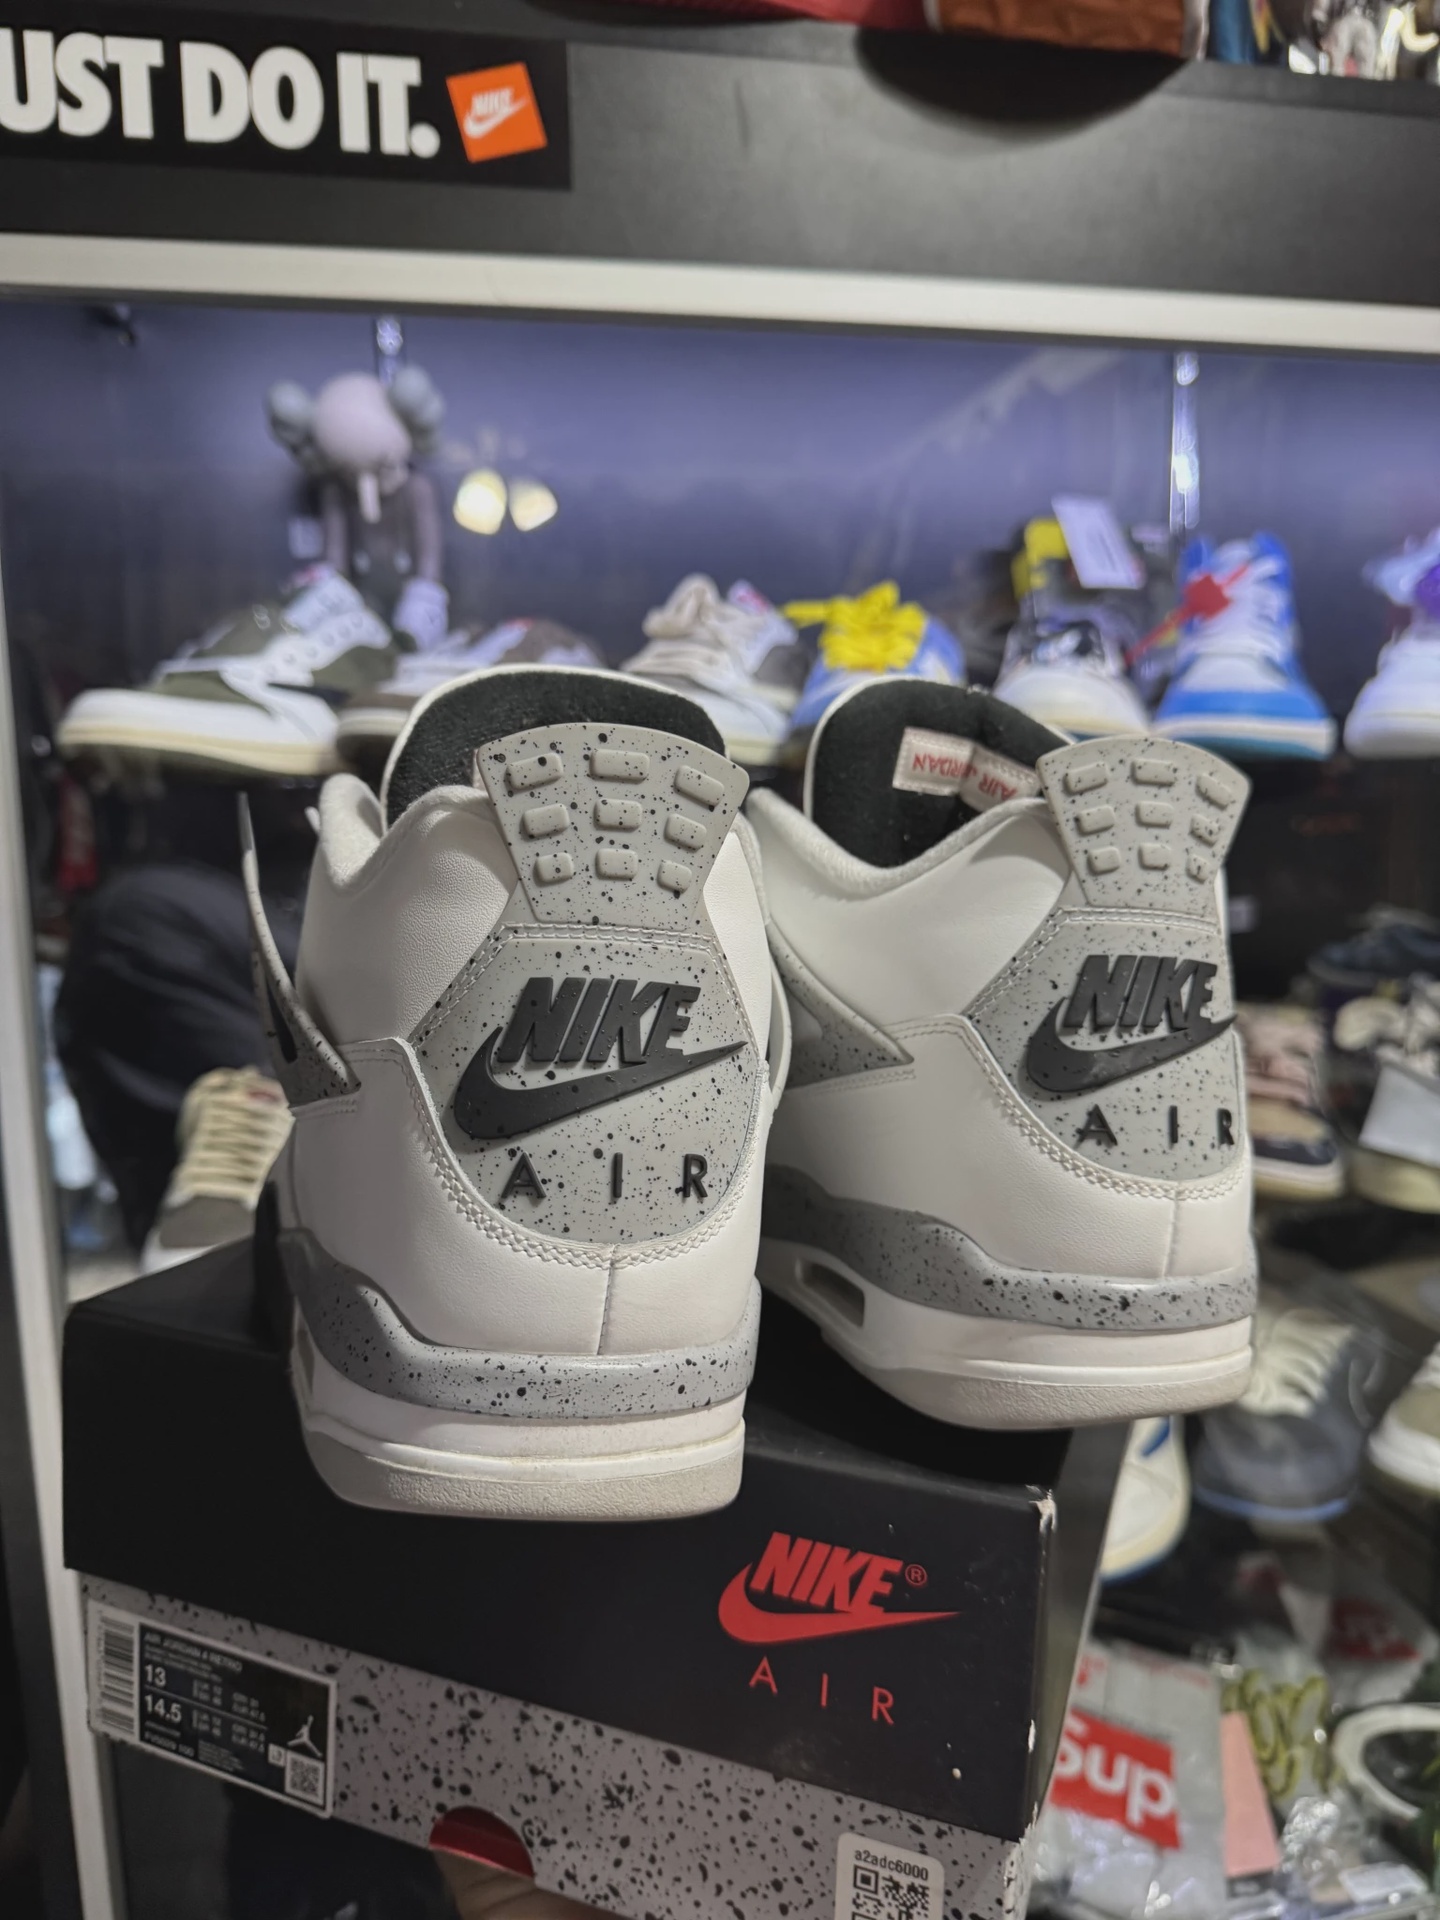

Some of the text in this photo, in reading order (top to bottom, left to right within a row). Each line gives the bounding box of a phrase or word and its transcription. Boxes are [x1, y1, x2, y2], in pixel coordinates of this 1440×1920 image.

[180, 41, 324, 149] DO
[337, 52, 440, 157] IT.
[496, 976, 702, 1065] NIKE
[1062, 954, 1218, 1033] NIKE
[749, 1531, 904, 1614] NIKE
[144, 1694, 182, 1723] 14.5
[145, 1664, 166, 1687] 13
[854, 1849, 929, 1882] a2adc6000
